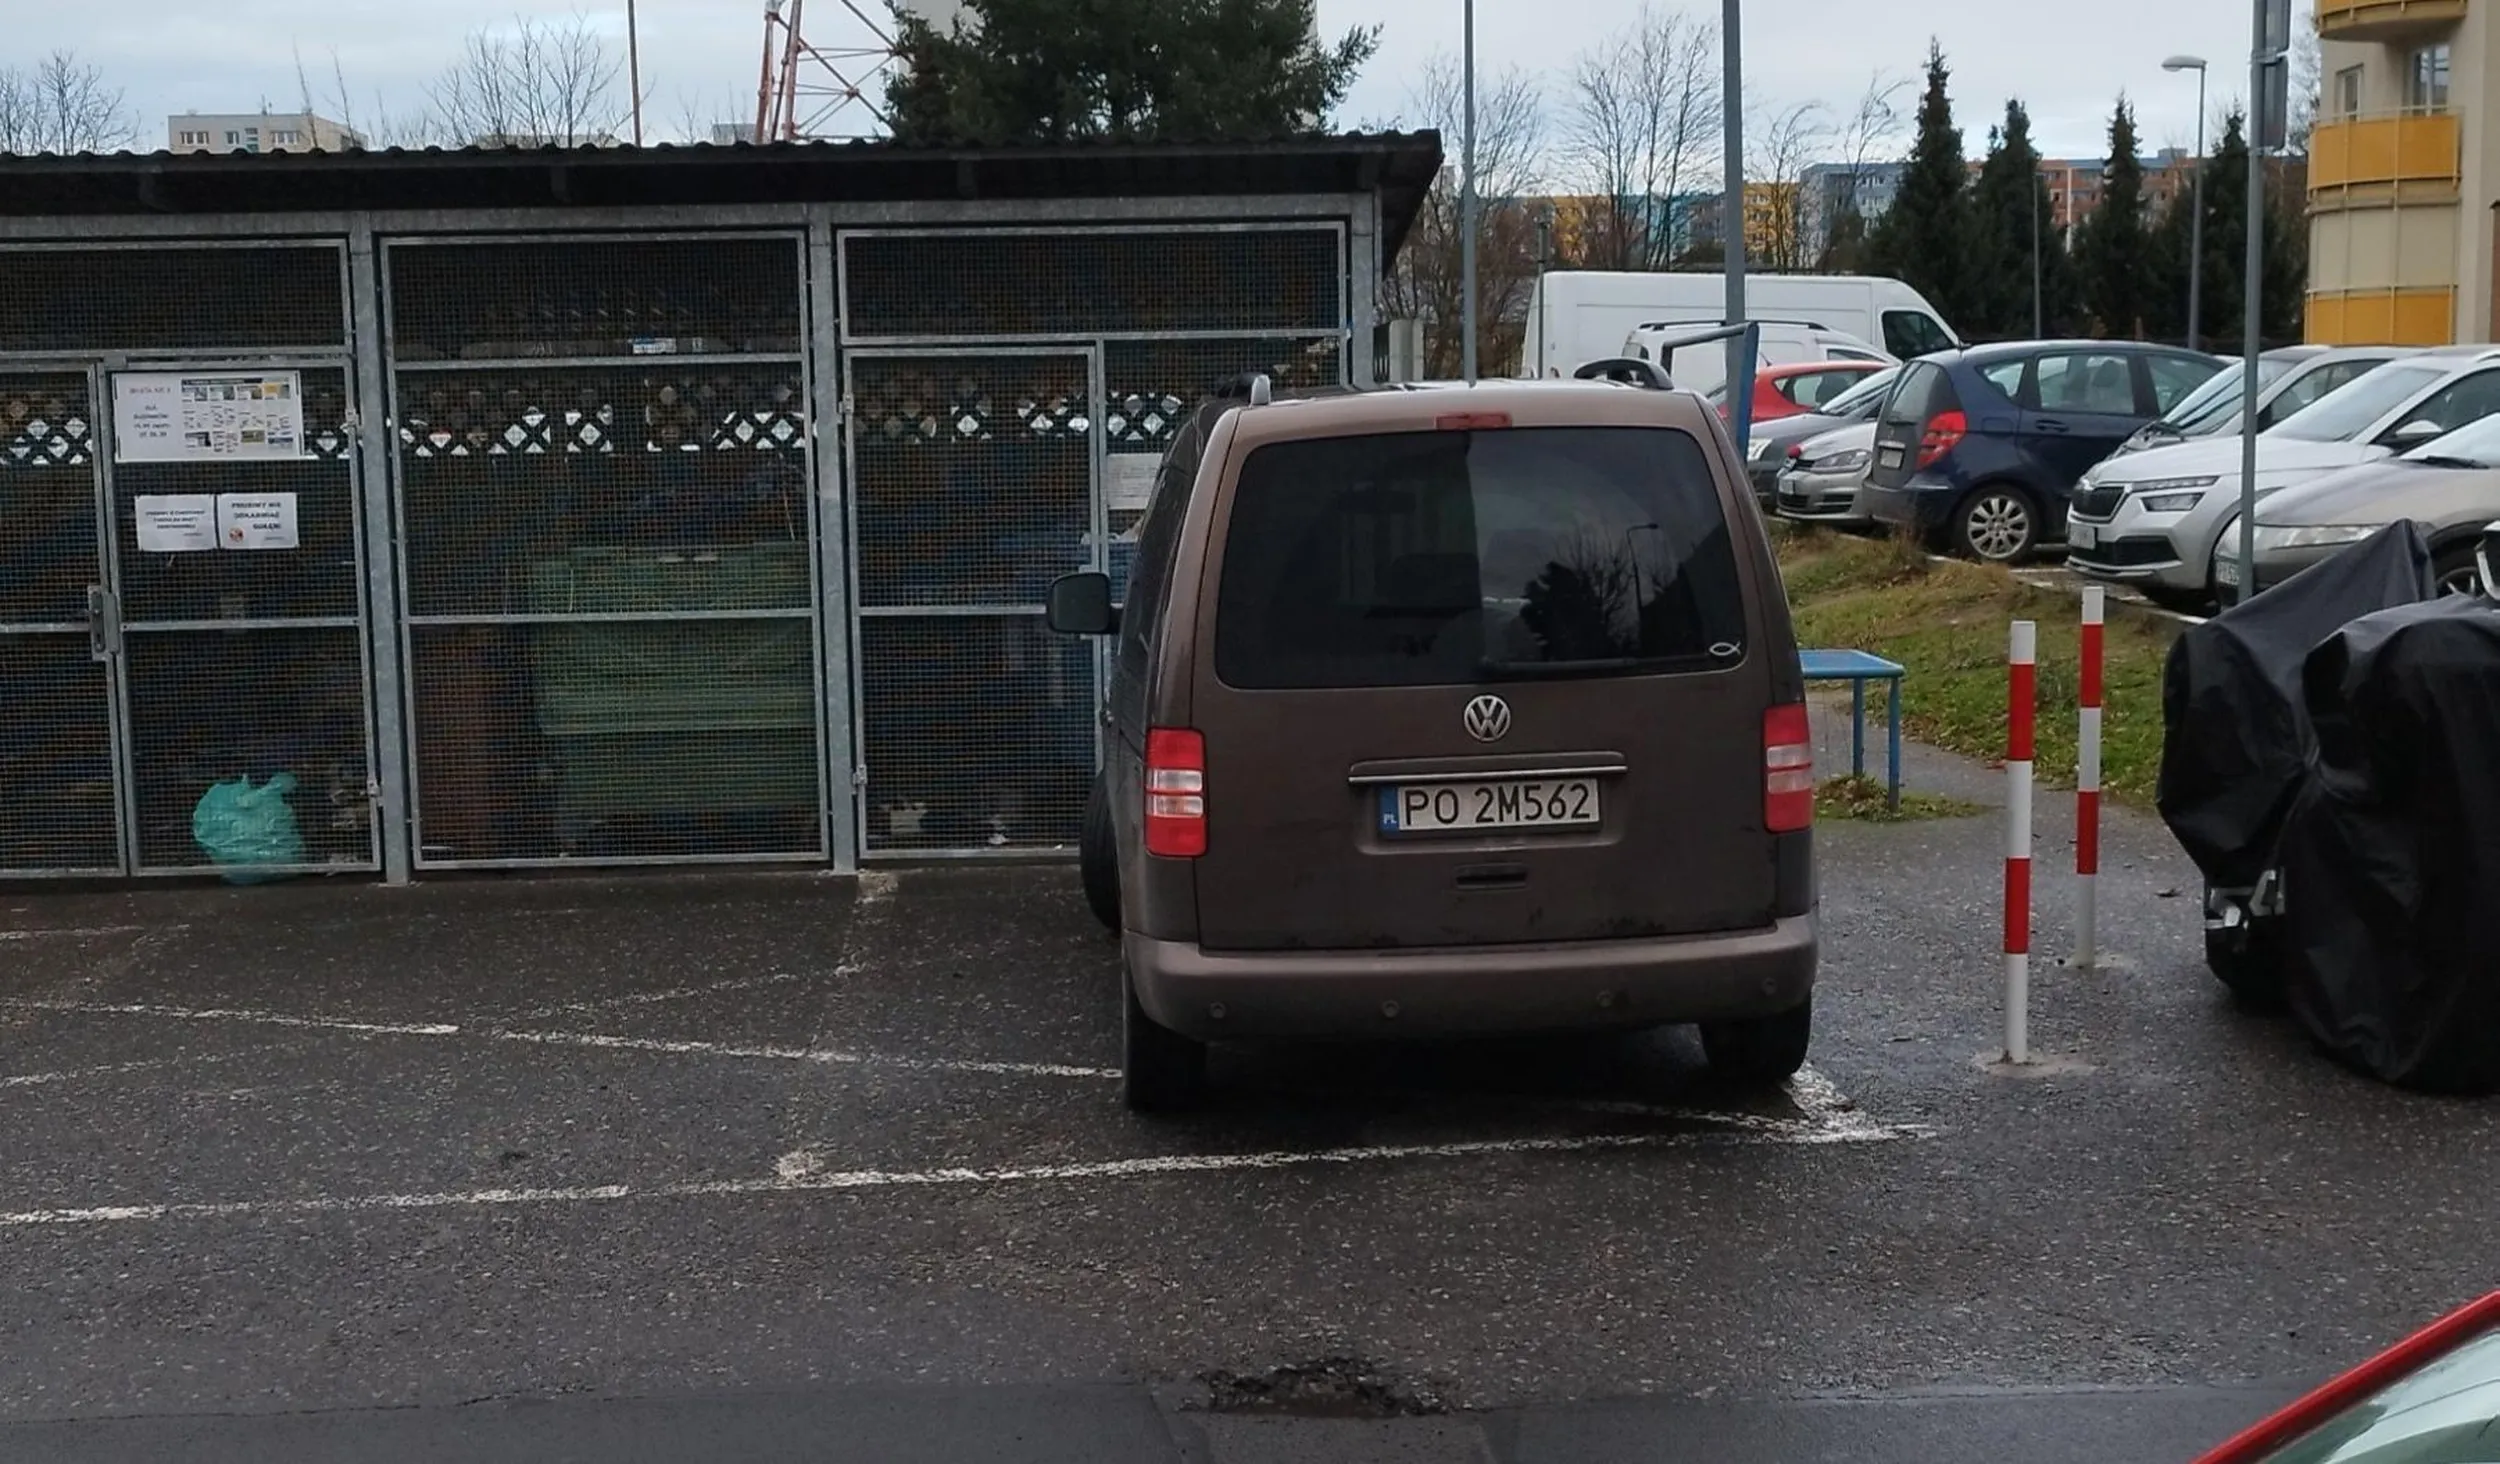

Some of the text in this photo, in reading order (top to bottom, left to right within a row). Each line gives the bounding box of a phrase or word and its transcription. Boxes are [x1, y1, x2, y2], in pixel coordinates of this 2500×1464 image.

[1464, 694, 1511, 742] VW
[1383, 812, 1397, 825] PL
[1403, 783, 1591, 826] PO 2M562
